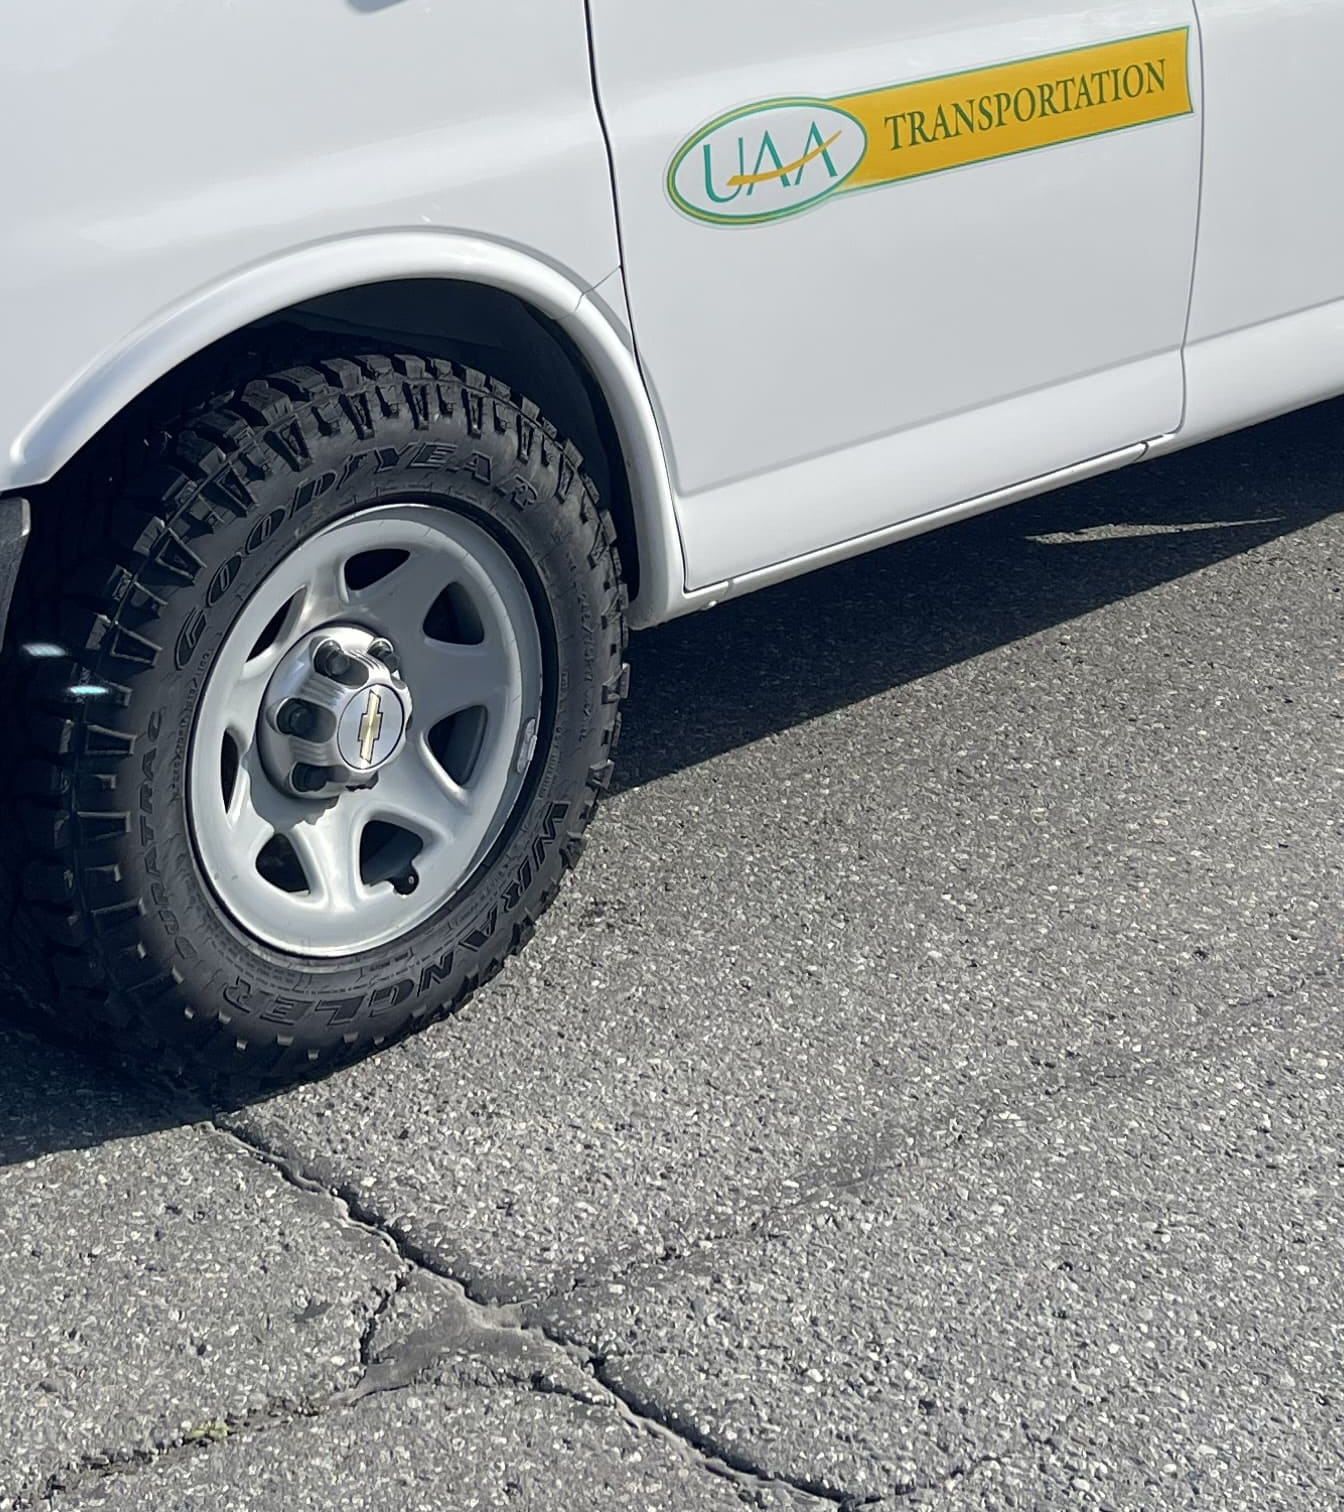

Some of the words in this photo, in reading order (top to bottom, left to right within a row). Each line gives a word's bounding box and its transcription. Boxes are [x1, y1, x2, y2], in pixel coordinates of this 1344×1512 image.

[702, 120, 840, 203] UAA
[883, 57, 1167, 152] TRANSPORTATION
[174, 441, 539, 671] GOODYEAR
[137, 705, 200, 961] DURATRAC
[222, 799, 571, 1028] WRANGLER
